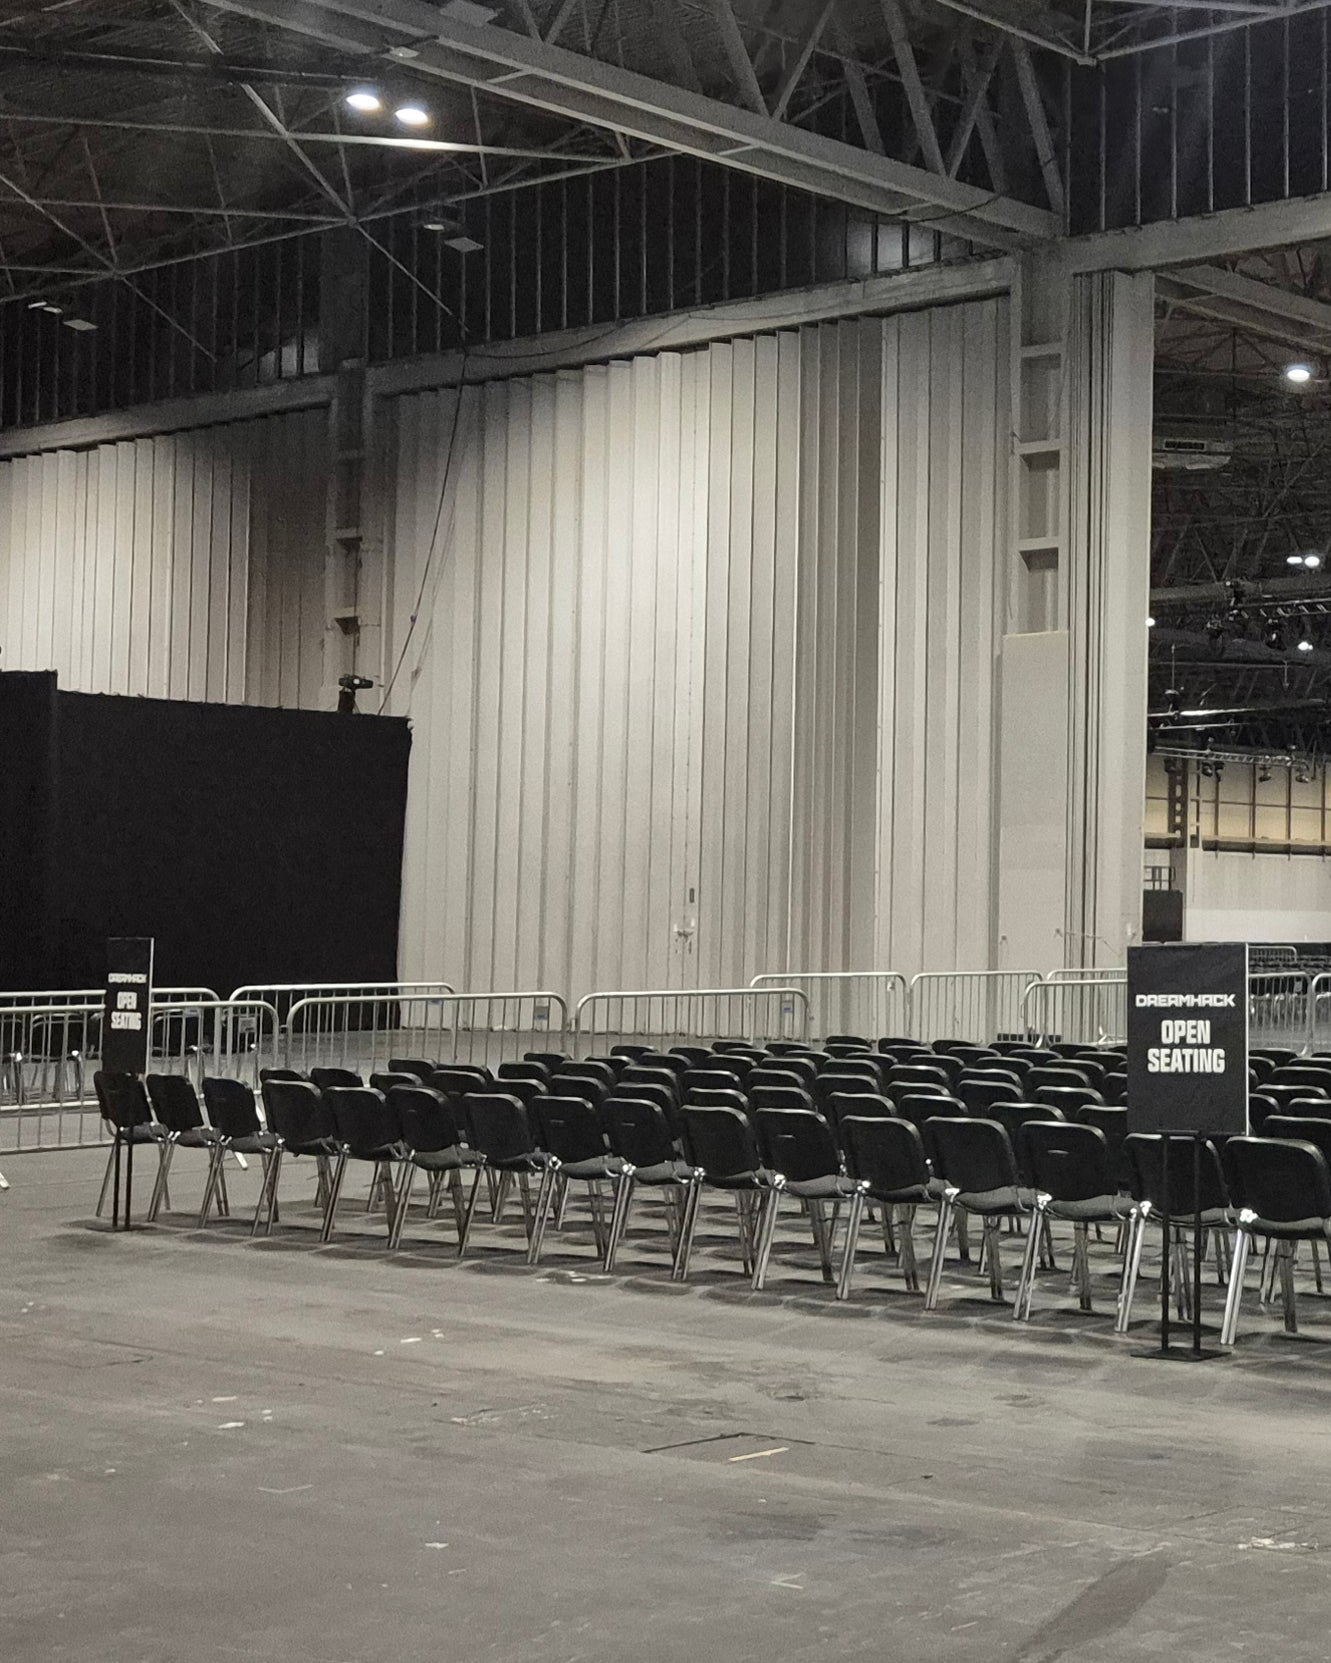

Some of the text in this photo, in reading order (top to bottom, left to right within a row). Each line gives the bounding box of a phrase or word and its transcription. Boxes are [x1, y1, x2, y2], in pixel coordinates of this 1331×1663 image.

[1135, 994, 1236, 1008] DREAMHACK
[1161, 1019, 1211, 1045] OPEN
[1147, 1048, 1226, 1074] SEATING
